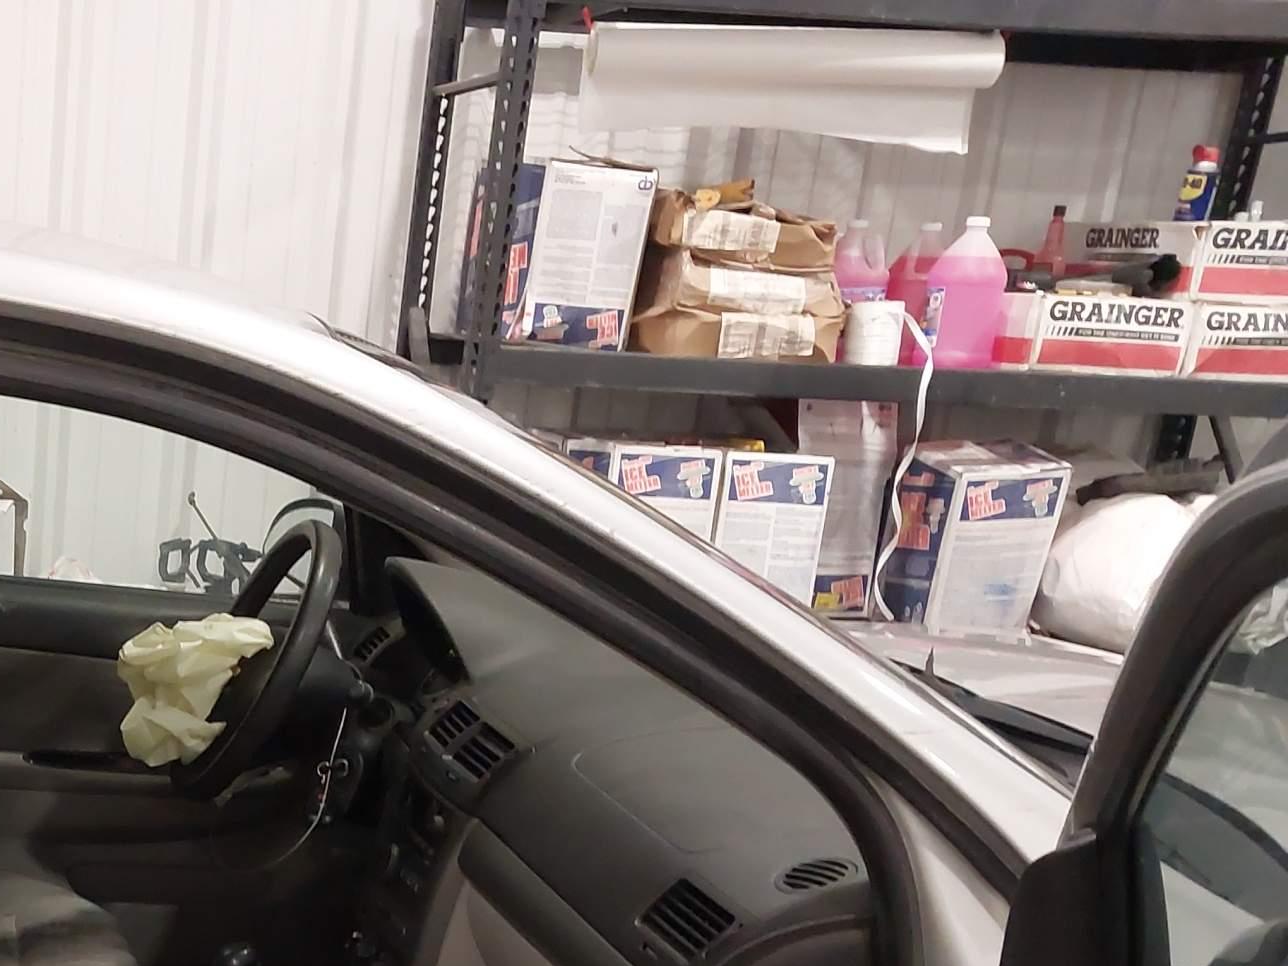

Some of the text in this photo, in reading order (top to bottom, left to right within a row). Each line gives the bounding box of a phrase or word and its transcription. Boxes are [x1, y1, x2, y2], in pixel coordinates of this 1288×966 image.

[1085, 227, 1160, 249] GRAINGER
[1049, 300, 1185, 329] GRAINGER
[736, 471, 755, 487] ICE
